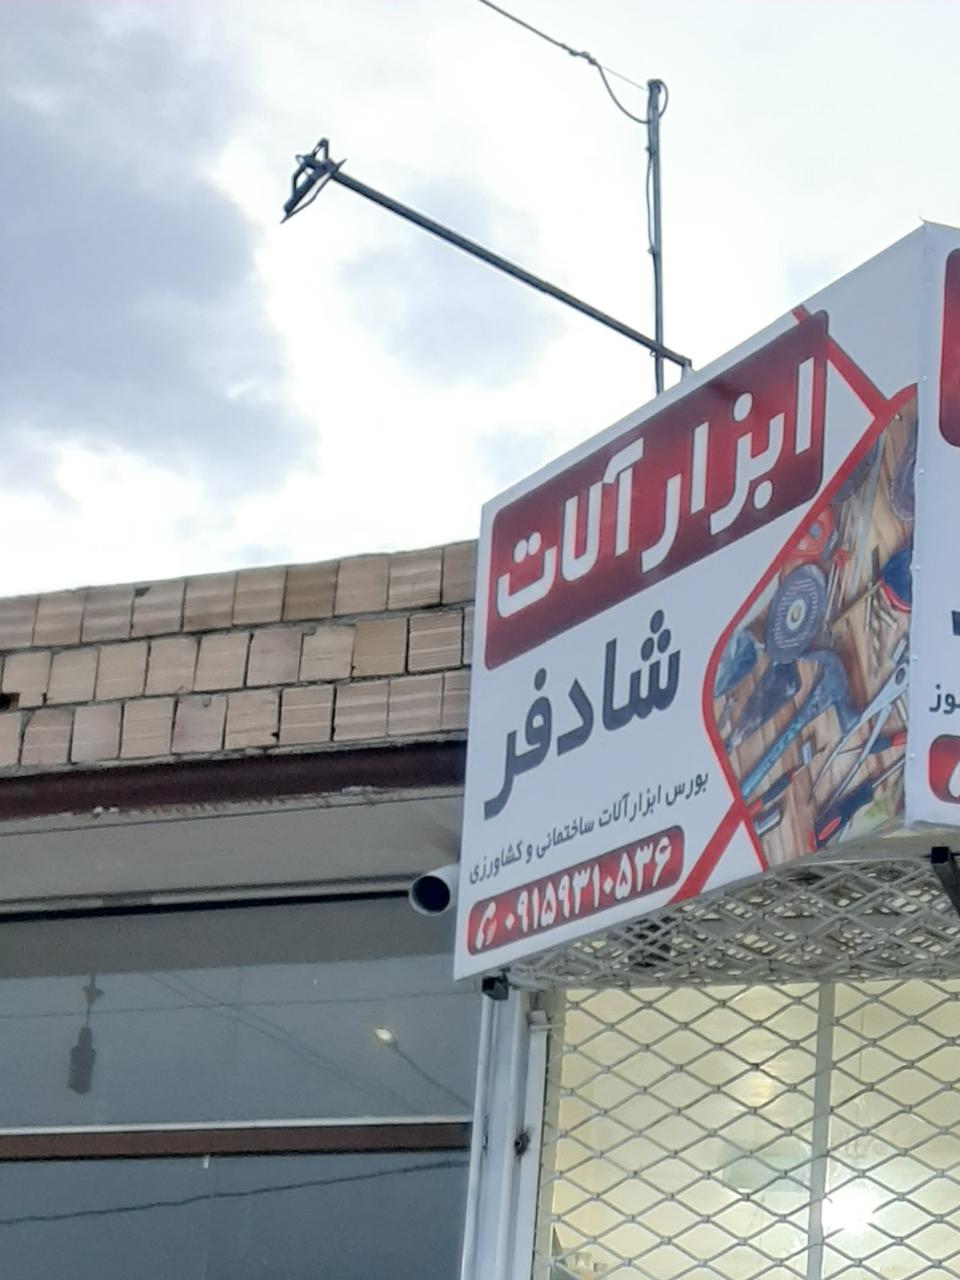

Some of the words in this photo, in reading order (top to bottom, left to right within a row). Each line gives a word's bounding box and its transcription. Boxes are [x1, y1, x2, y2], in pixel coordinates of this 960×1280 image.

[484, 608, 682, 820] شادفر
[665, 772, 709, 806] بورس
[525, 843, 533, 864] و
[536, 816, 595, 859] ساختمانی
[469, 840, 523, 885] کشاورزی
[504, 836, 672, 933] ۰۹۱۵۹۳۱۰۵۳۶
